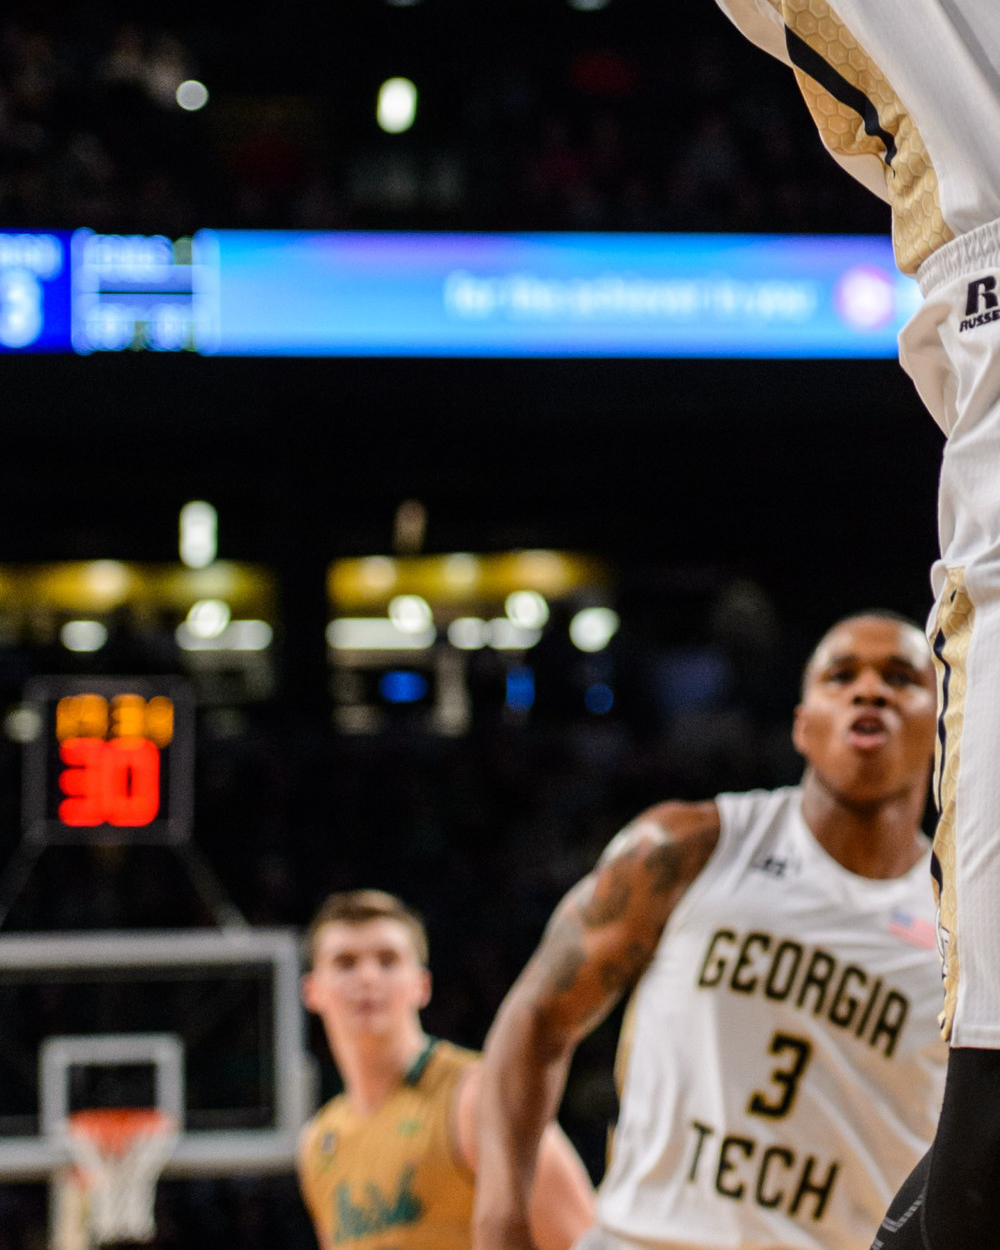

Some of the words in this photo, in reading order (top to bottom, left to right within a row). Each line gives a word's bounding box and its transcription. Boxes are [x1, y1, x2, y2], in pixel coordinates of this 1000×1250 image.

[58, 737, 160, 827] 30
[697, 927, 912, 1058] GEORGIA
[747, 1031, 816, 1120] 3
[689, 1117, 840, 1222] TECH
